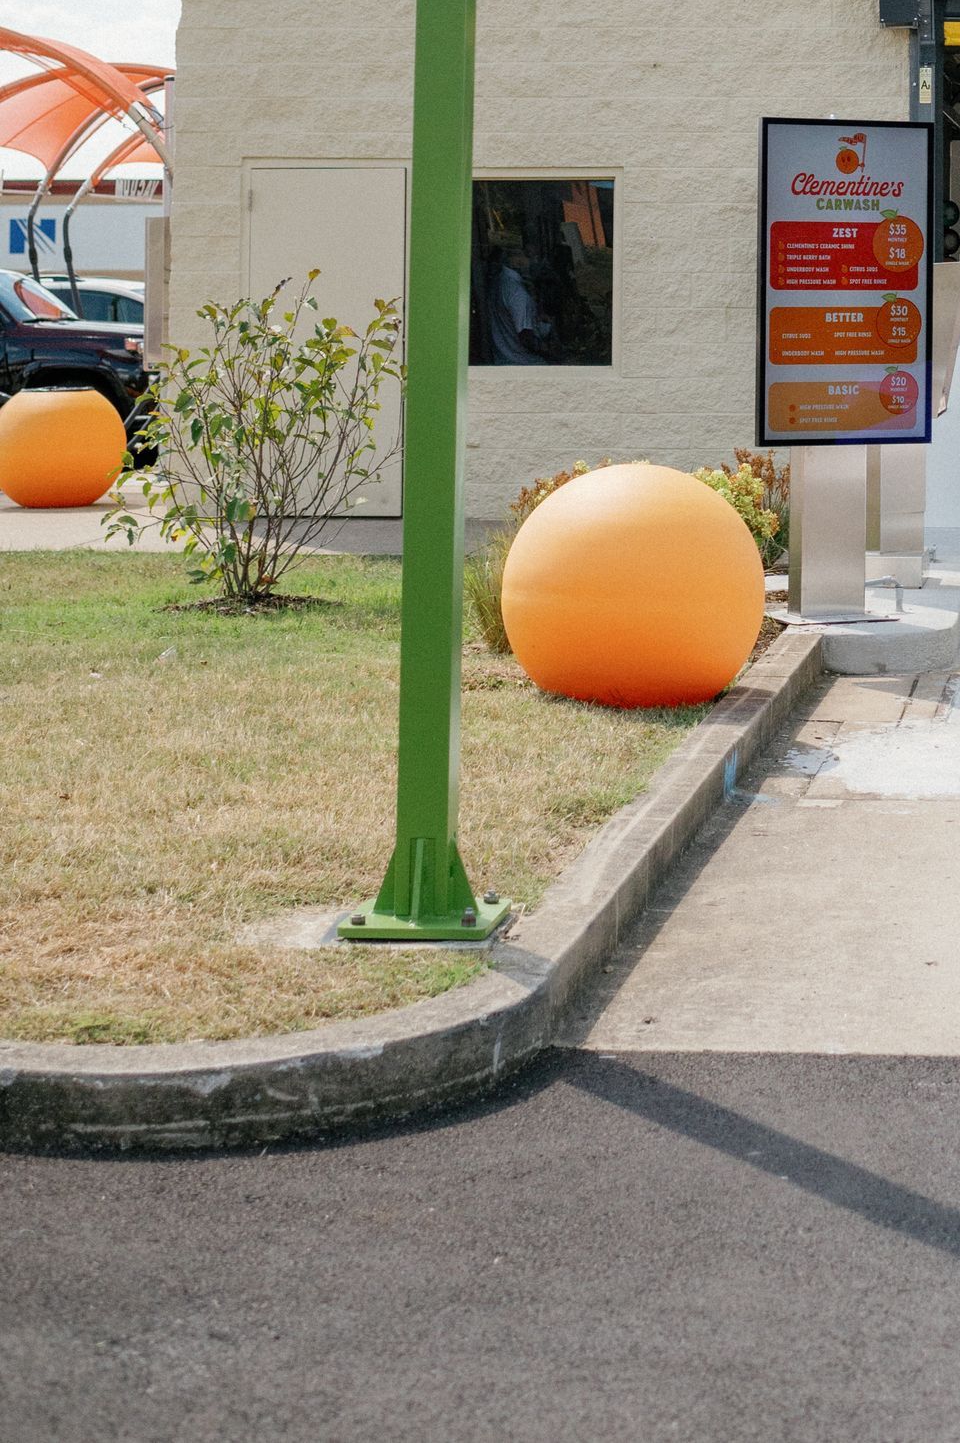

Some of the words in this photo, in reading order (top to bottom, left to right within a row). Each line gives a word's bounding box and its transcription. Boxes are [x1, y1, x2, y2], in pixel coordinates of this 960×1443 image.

[791, 172, 904, 197] Clementine's
[816, 198, 880, 211] CARWASH
[832, 227, 858, 238] ZEST
[889, 222, 907, 236] $35
[889, 246, 906, 259] $18
[890, 304, 908, 317] $30
[825, 312, 864, 323] BETTER
[892, 326, 907, 336] $15
[891, 376, 907, 387] $20
[827, 384, 860, 396] BASIC
